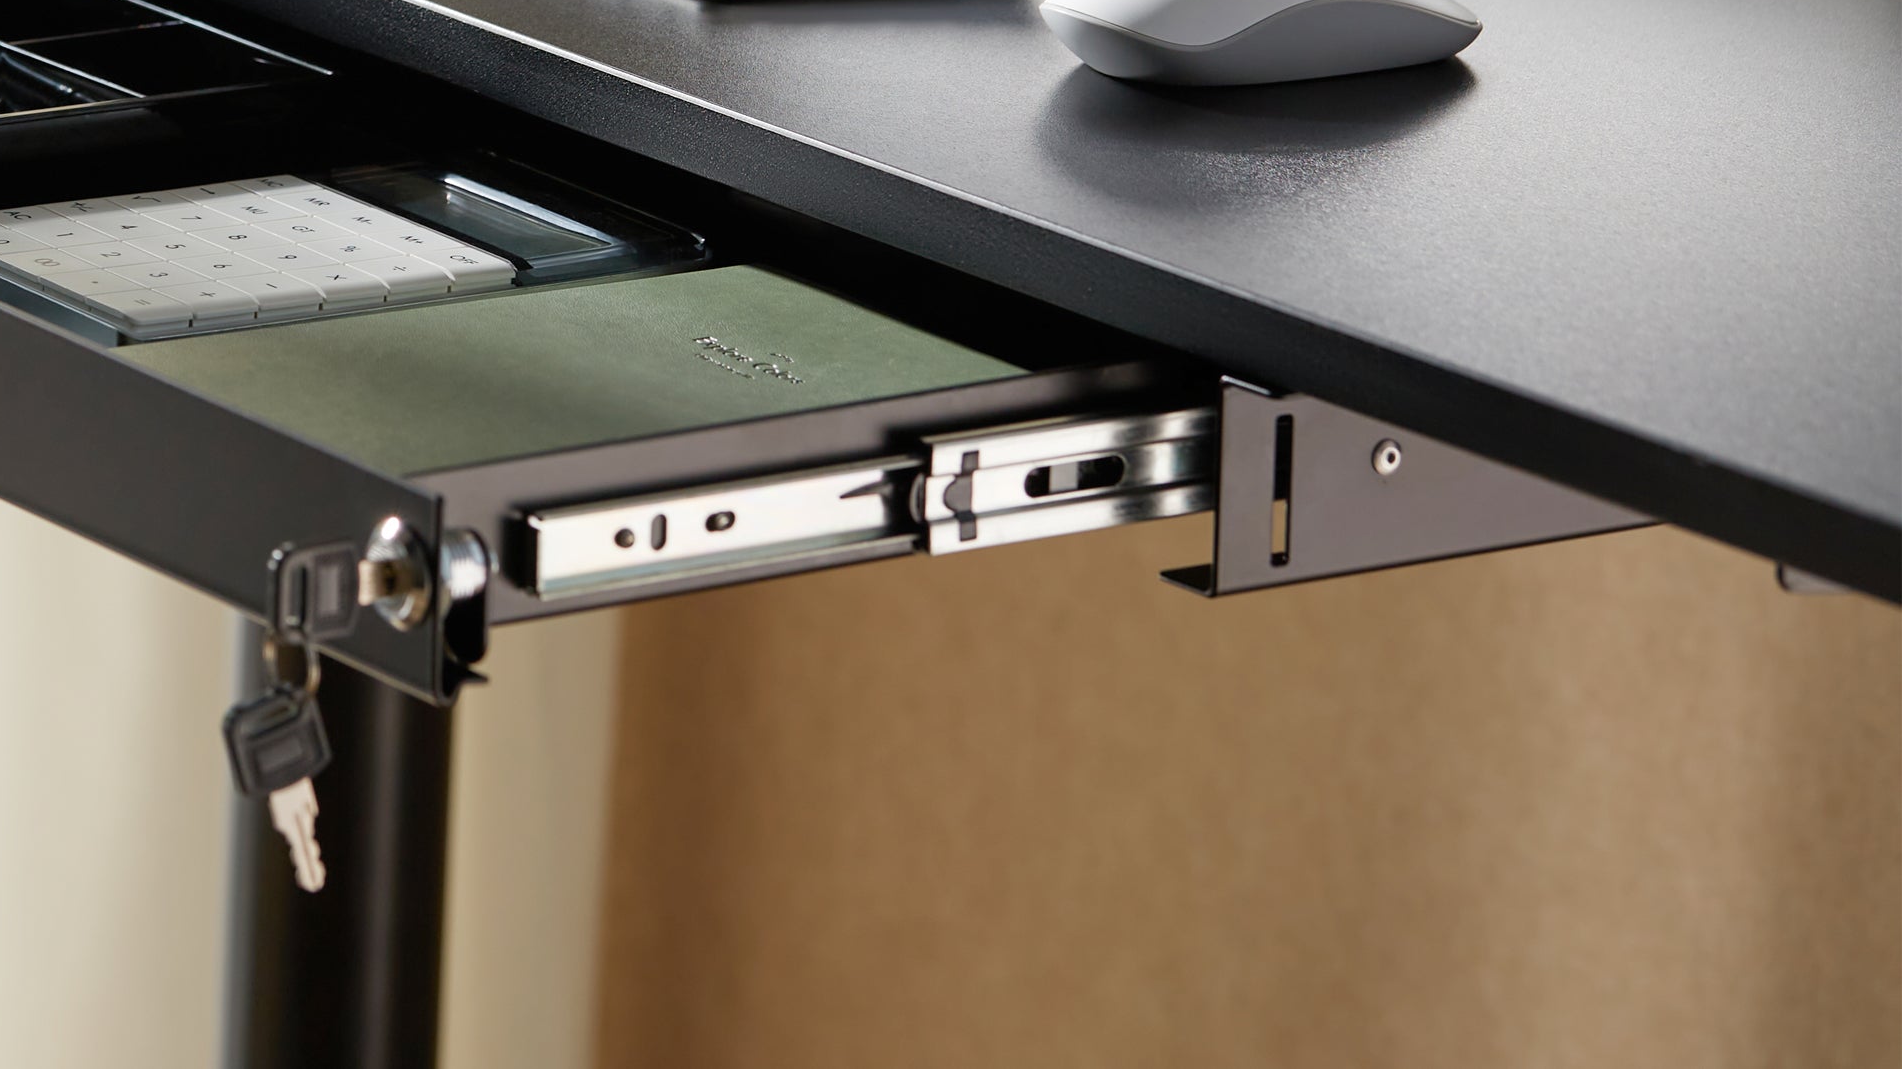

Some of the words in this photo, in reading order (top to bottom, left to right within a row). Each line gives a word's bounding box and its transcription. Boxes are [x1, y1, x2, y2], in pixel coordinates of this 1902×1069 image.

[305, 198, 330, 206] MR
[3, 211, 32, 221] AC
[450, 255, 479, 265] OFF
